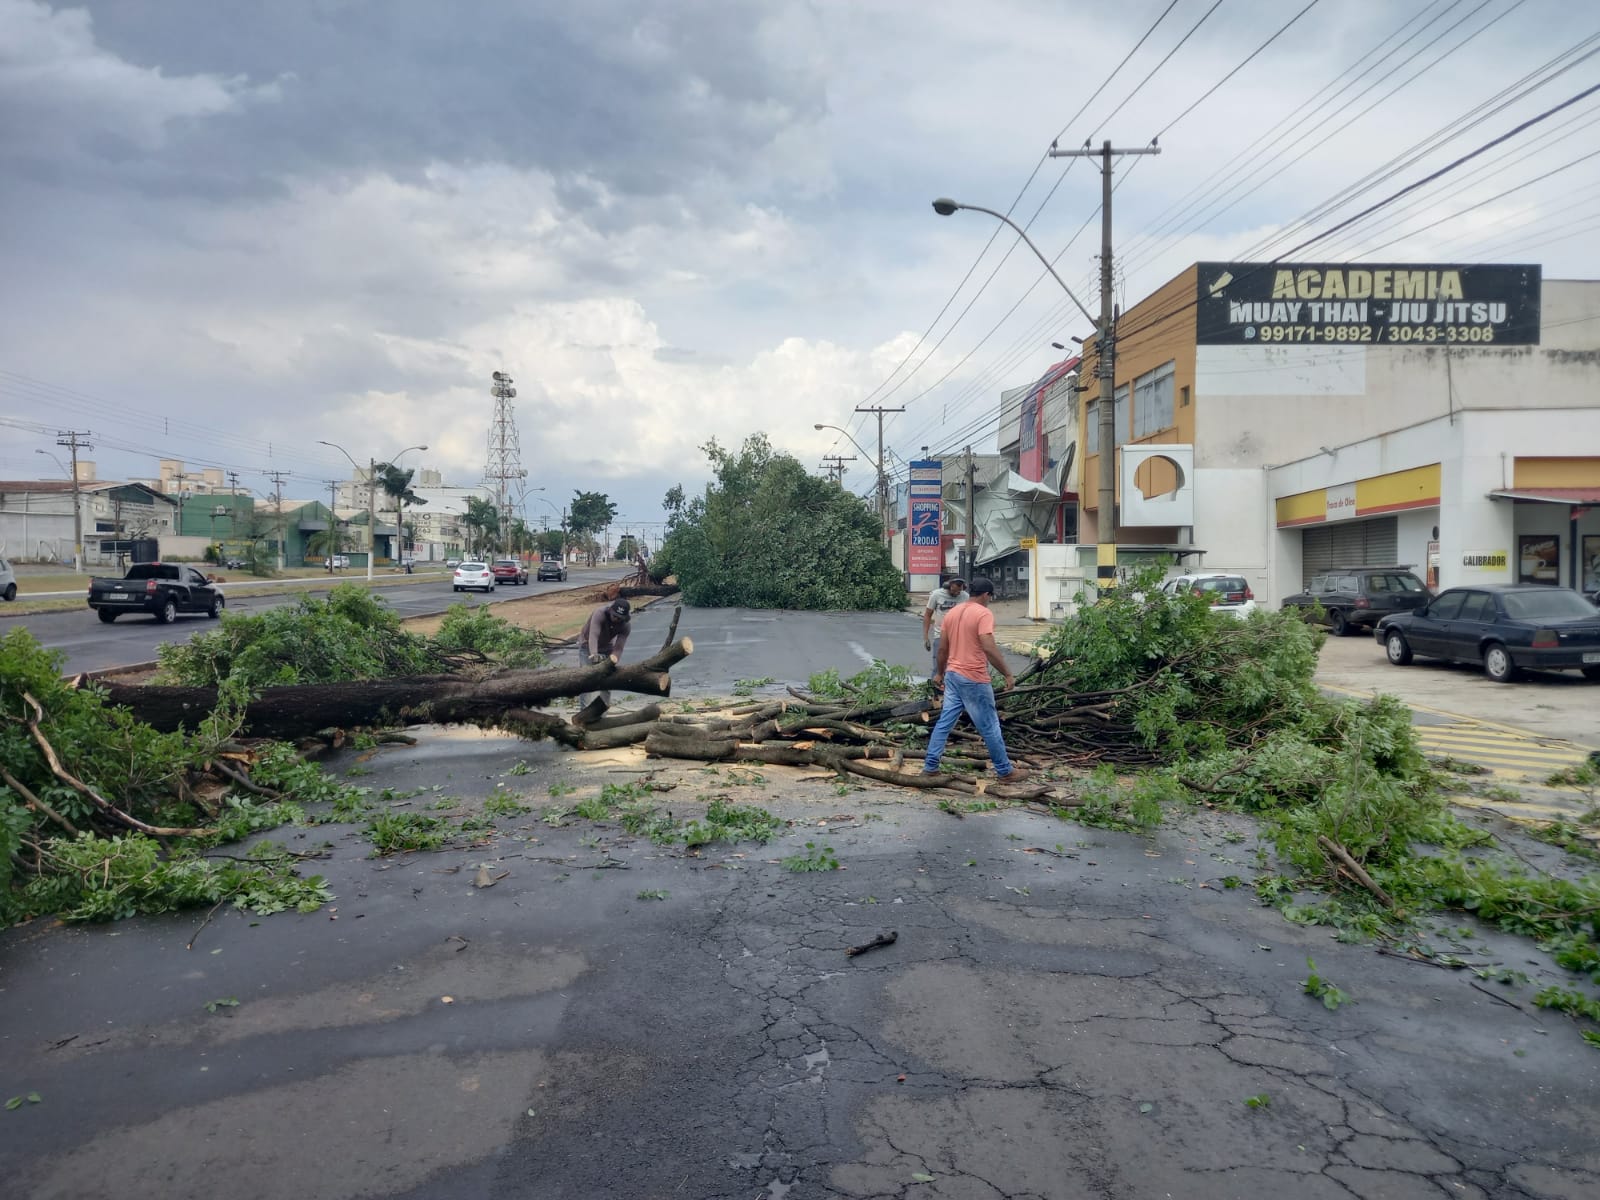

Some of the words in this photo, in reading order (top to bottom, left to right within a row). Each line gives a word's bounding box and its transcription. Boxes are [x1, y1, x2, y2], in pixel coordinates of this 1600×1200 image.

[1271, 269, 1464, 300] ACADEMIA
[1229, 301, 1302, 324] MUAY
[1308, 302, 1368, 323] THAI
[1389, 302, 1428, 324] JIU
[1433, 302, 1507, 324] JITSU
[1260, 326, 1372, 342] 99171-9892
[1376, 326, 1385, 342] /
[1388, 326, 1494, 342] 3043-3308
[913, 503, 938, 512] SHOPPING
[1463, 555, 1506, 566] CALIBRADOR
